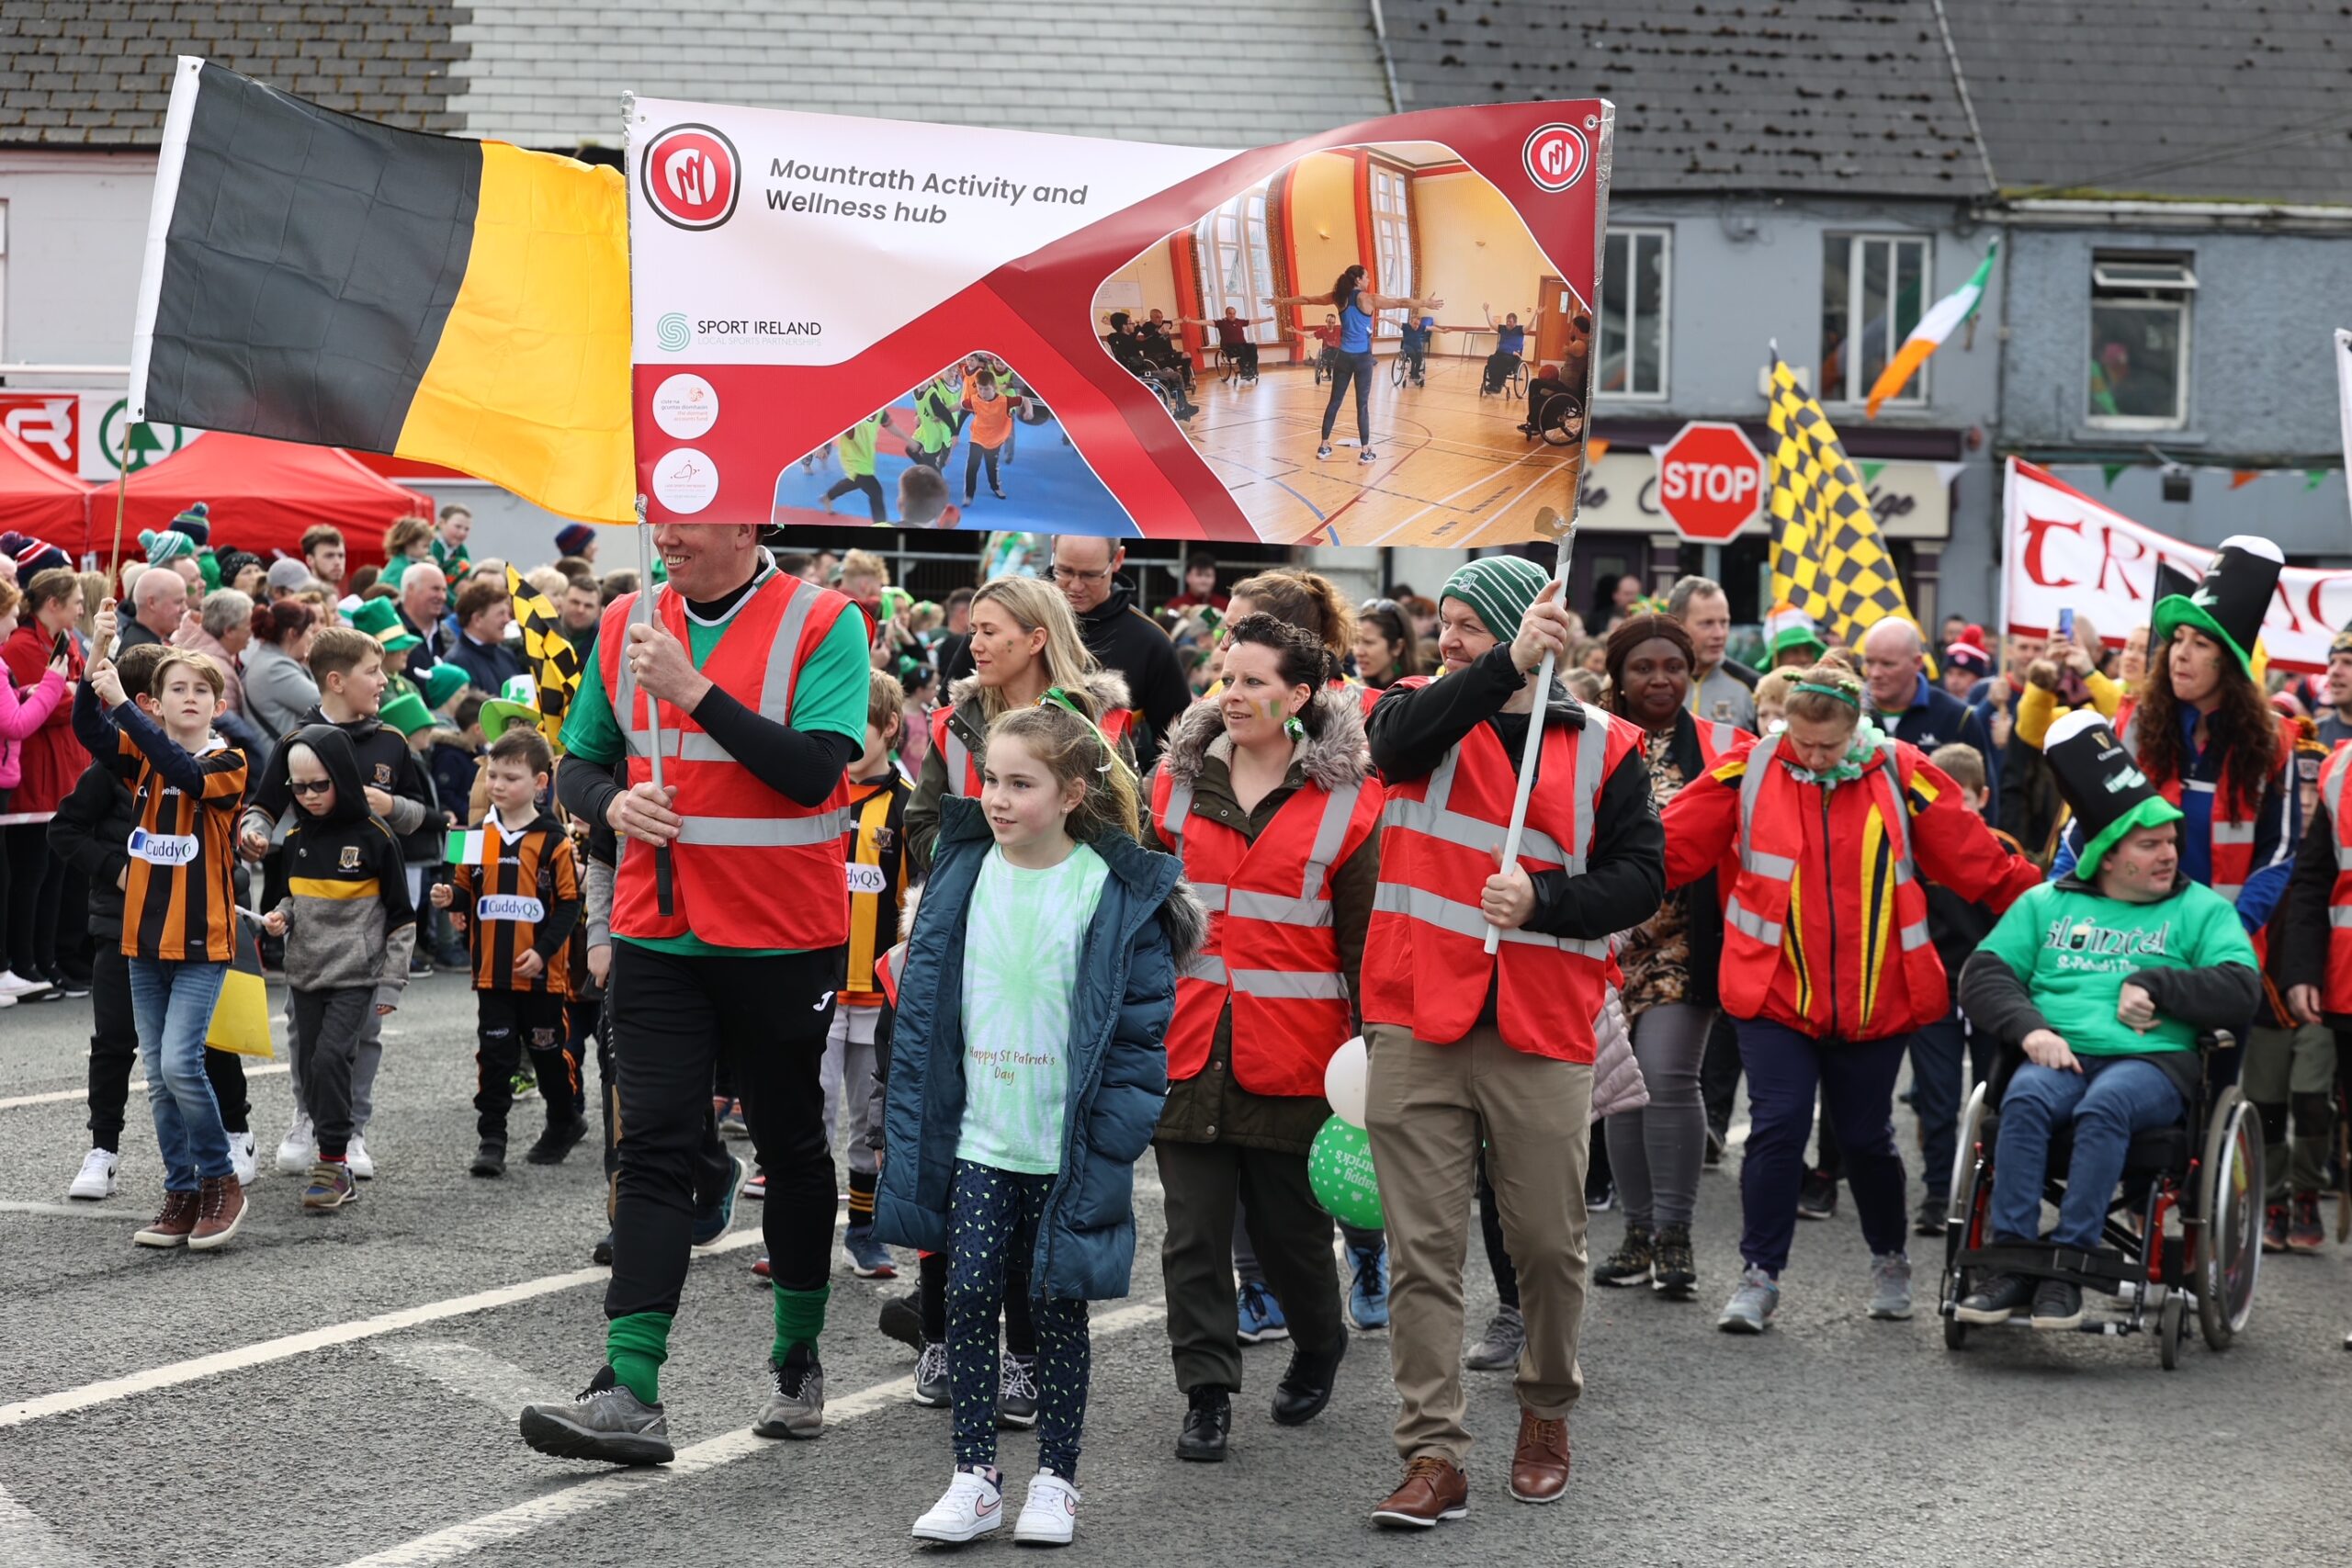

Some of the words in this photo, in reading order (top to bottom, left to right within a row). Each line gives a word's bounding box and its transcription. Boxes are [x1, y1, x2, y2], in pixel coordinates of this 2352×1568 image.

[770, 157, 915, 191] Mountrath
[922, 173, 1027, 207] Activity
[1033, 184, 1089, 205] and
[766, 189, 888, 220] Wellness
[893, 201, 947, 224] hub
[697, 320, 749, 334] SPORT
[754, 321, 821, 335] IRELAND
[698, 337, 726, 345] LOCAL
[729, 337, 760, 346] SPORTS
[763, 337, 822, 347] PARTNERSHIPS
[1664, 462, 1756, 503] STOP
[846, 868, 881, 889] dyQS
[489, 899, 540, 919] CuddyQS
[969, 1046, 998, 1066] Happy
[1000, 1050, 1011, 1063] St
[1014, 1051, 1056, 1066] Patrick's
[994, 1066, 1015, 1086] Day
[1335, 1149, 1375, 1174] atrick's
